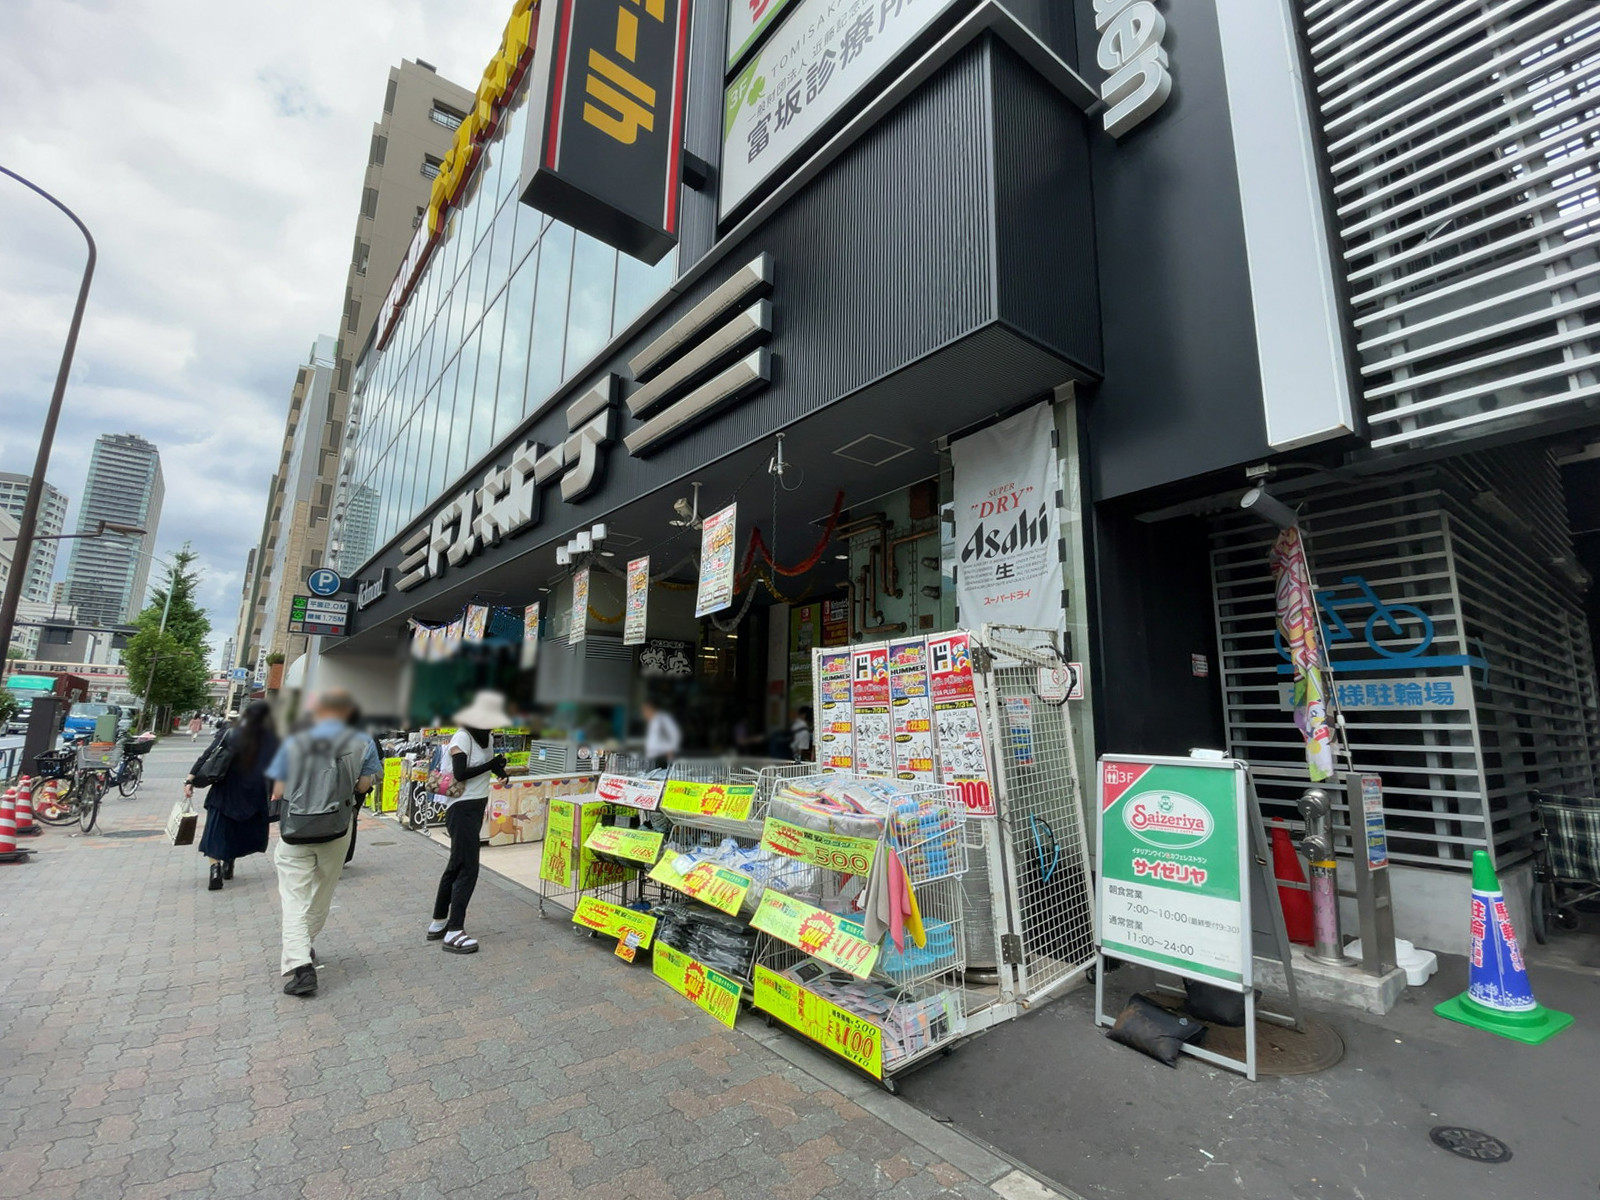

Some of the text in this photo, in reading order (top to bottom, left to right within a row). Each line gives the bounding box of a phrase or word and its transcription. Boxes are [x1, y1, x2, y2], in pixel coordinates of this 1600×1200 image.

[771, 0, 843, 78] TOMISAK
[583, 0, 666, 144] ーテ
[729, 78, 748, 110] 3F
[988, 482, 1015, 498] SUPER
[961, 502, 1049, 563] Asahi
[318, 572, 333, 587] P
[995, 563, 1015, 580] 生
[984, 589, 1032, 605] スーパードライ
[890, 665, 926, 675] HUMMER
[1118, 772, 1133, 783] 3F
[1131, 804, 1205, 830] Saizeriya
[814, 846, 869, 872] 500
[1132, 857, 1207, 886] サイゼリヤ
[1109, 884, 1143, 900] 朝食営業
[1108, 914, 1143, 931] 通常営業
[800, 926, 829, 948] SALE
[837, 938, 872, 965] 119
[854, 1019, 877, 1037] 500
[842, 1026, 874, 1060] 100
